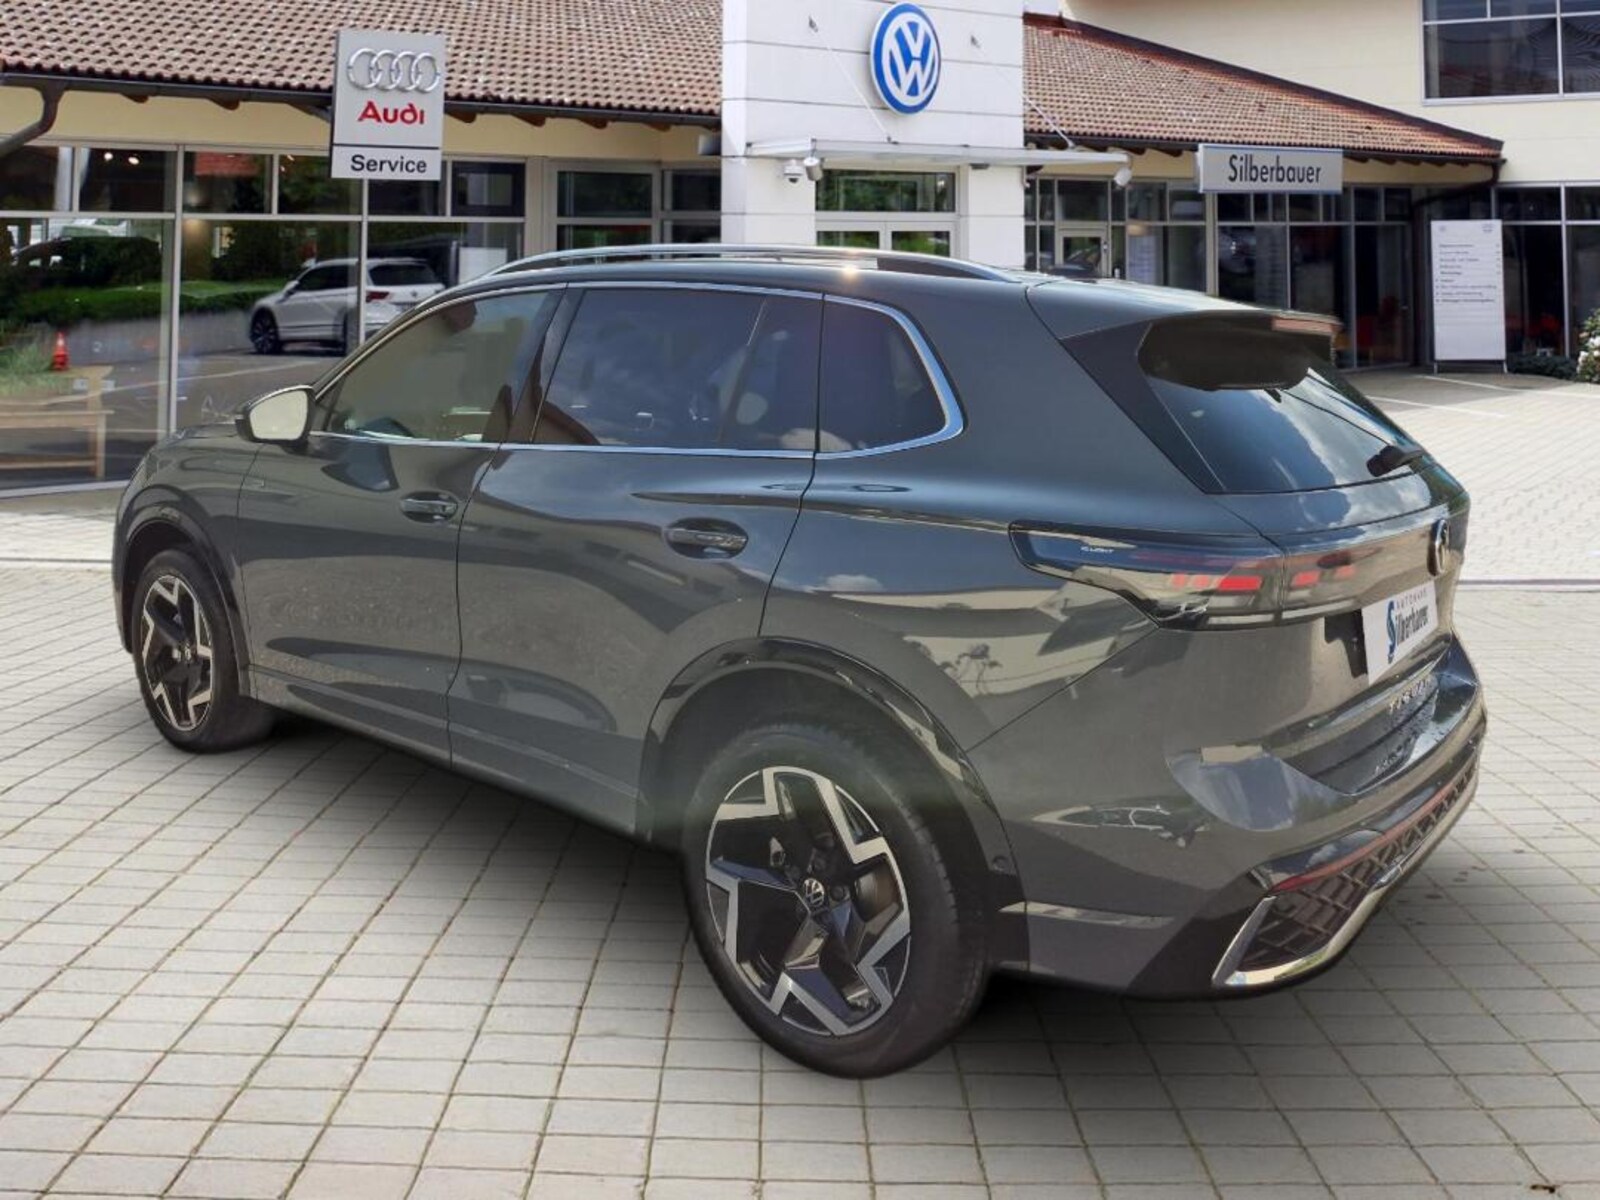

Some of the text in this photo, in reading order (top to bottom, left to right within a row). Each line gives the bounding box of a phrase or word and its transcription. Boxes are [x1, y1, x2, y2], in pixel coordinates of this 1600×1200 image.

[357, 101, 425, 125] Audi
[351, 154, 427, 173] Service
[1228, 154, 1321, 183] Silberbauer
